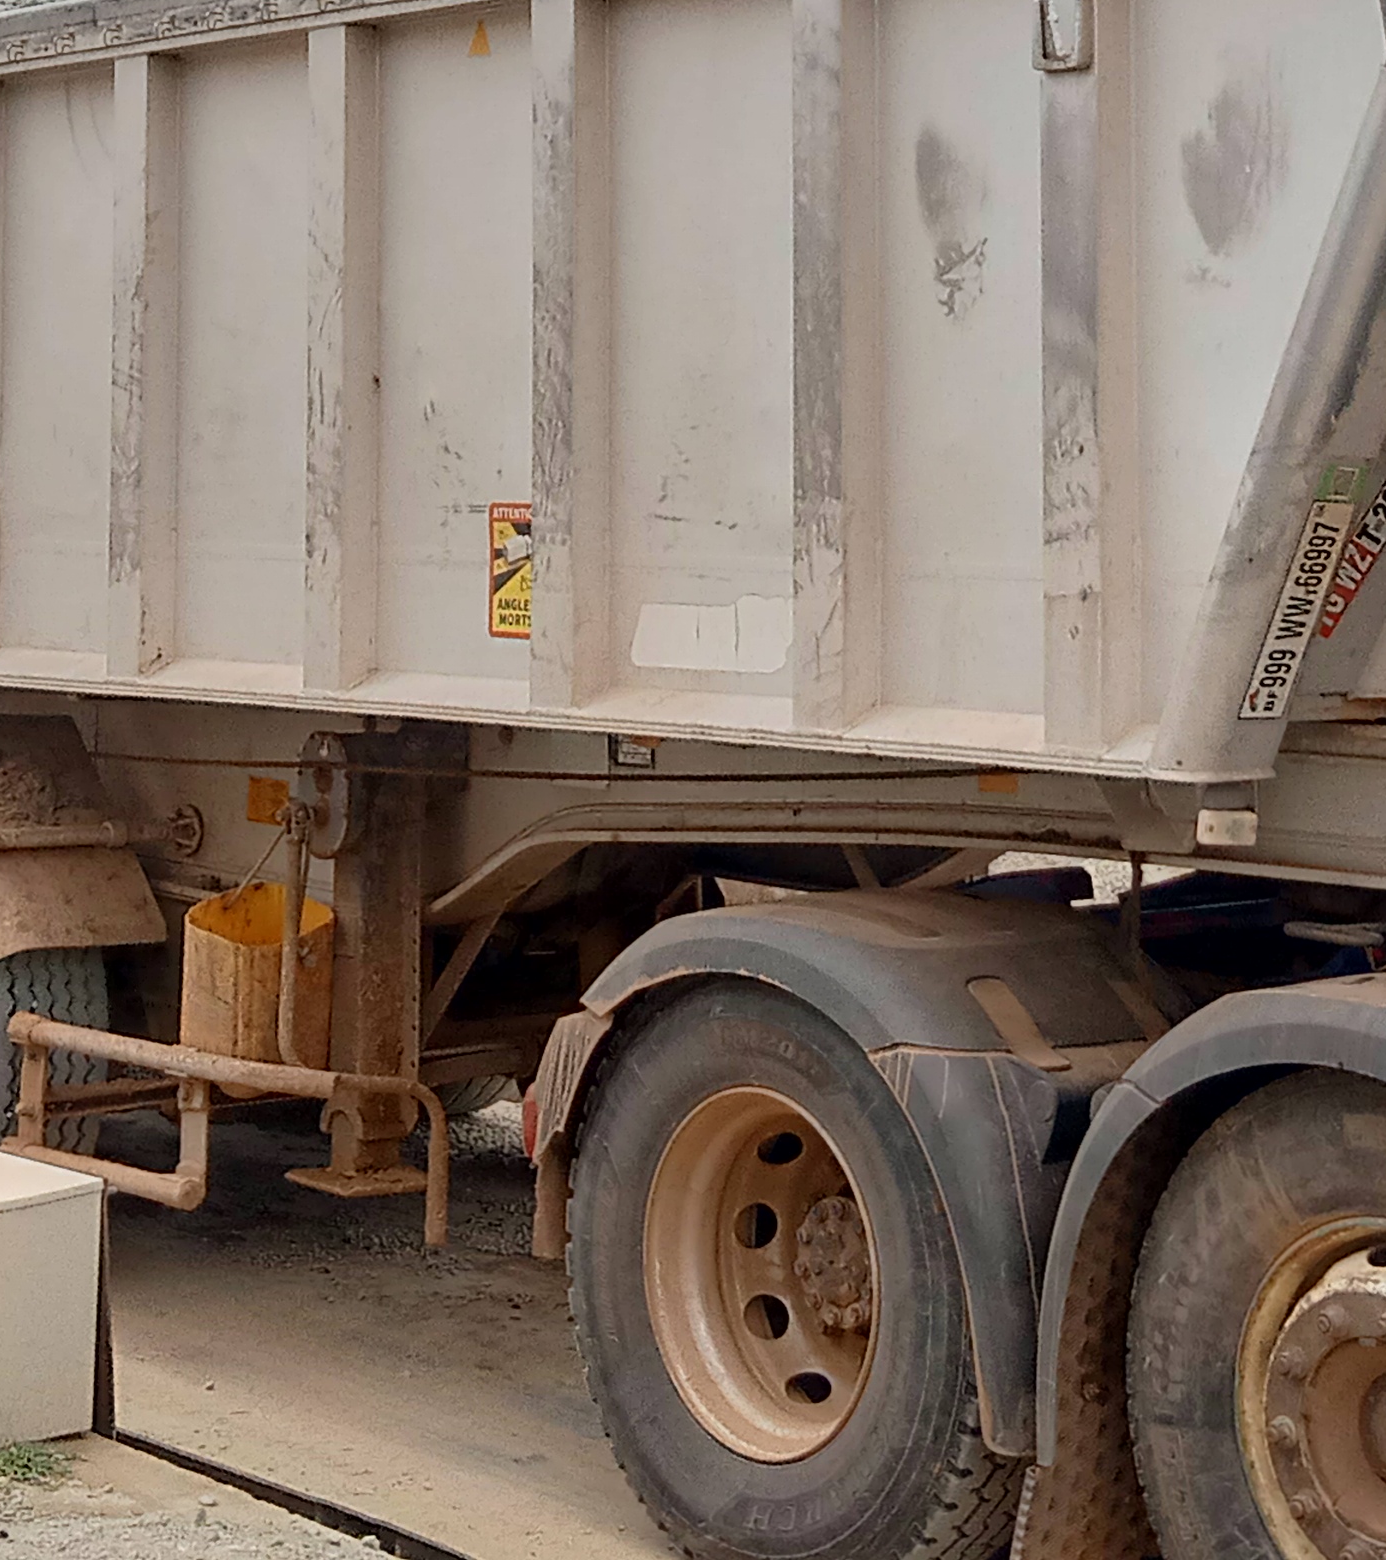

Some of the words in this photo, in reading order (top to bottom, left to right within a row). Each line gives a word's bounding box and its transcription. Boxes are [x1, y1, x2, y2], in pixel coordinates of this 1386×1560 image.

[1295, 521, 1340, 590] 66997
[1274, 596, 1314, 640] WW
[1259, 649, 1296, 688] 999
